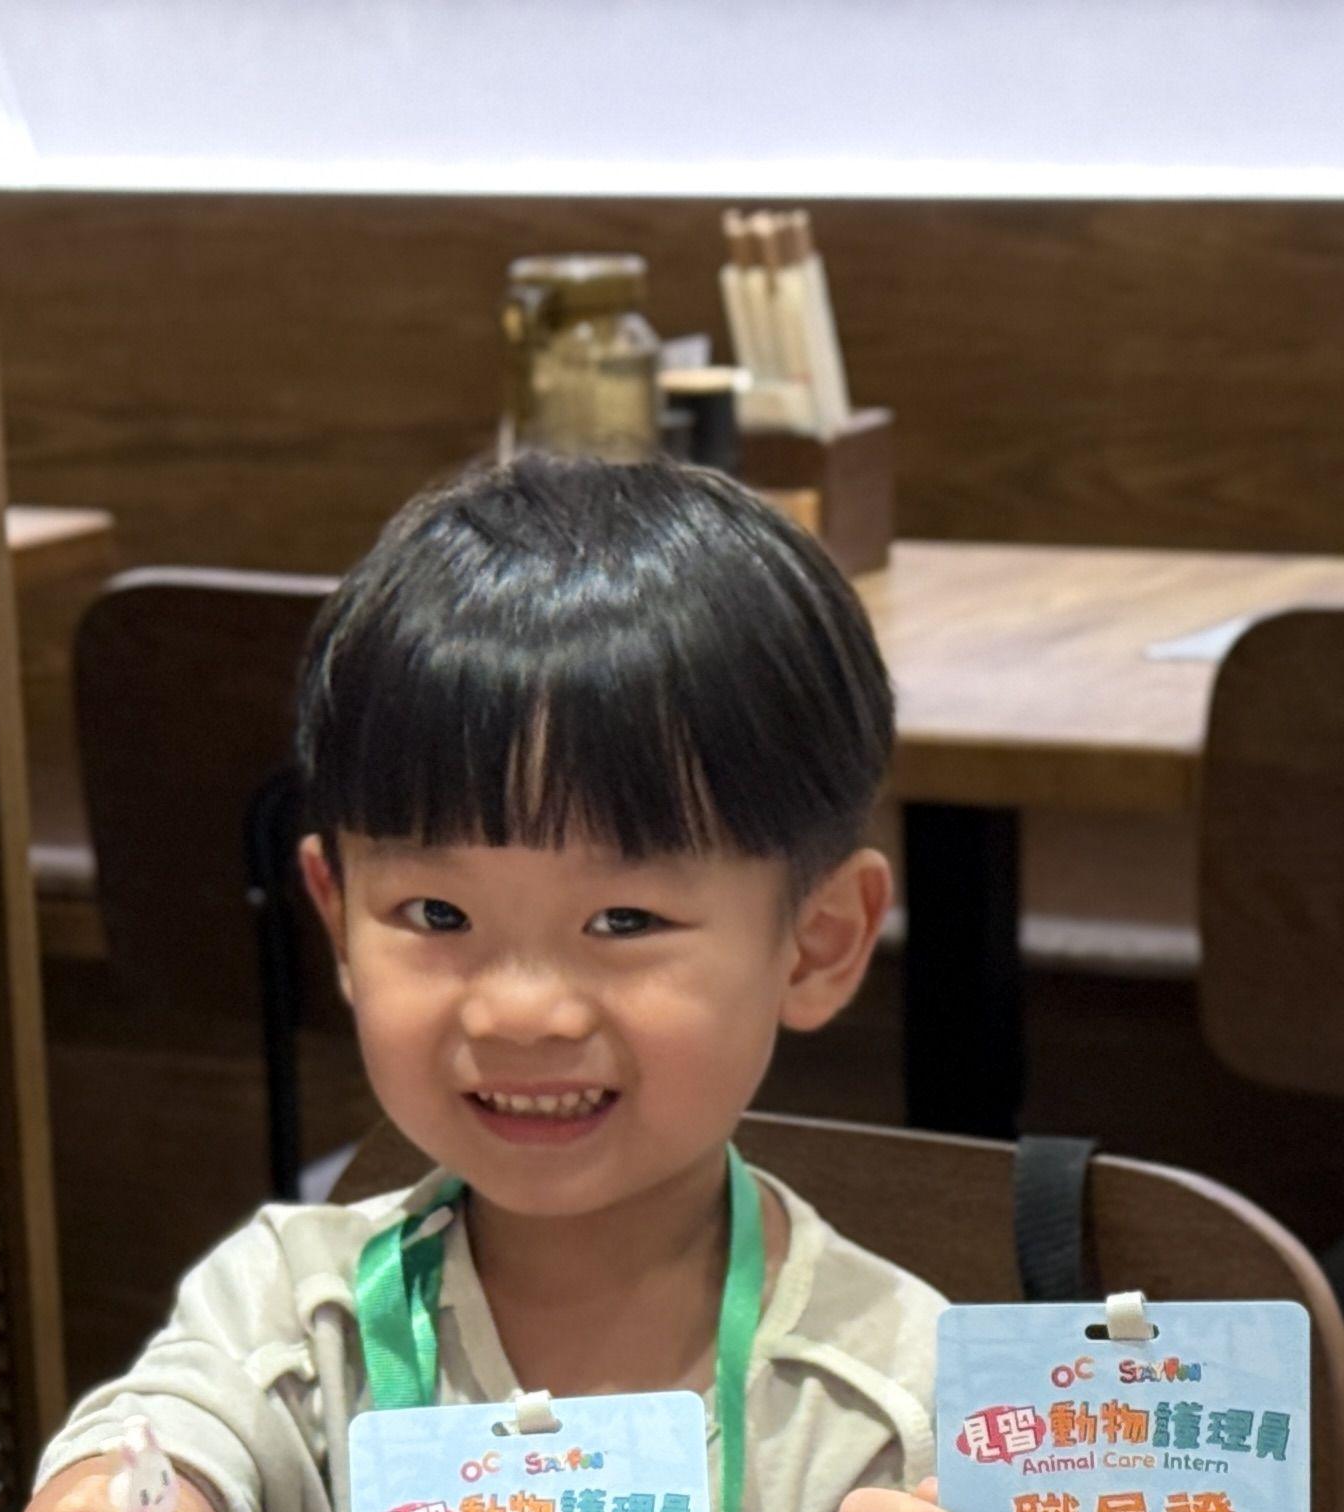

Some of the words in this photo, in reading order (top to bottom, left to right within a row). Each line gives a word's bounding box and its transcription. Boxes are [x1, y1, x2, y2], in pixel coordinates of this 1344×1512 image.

[963, 1399, 1291, 1463] 見習動物護理員
[1022, 1451, 1094, 1475] Animal
[1102, 1452, 1156, 1468] Care
[1163, 1452, 1229, 1473] Intern
